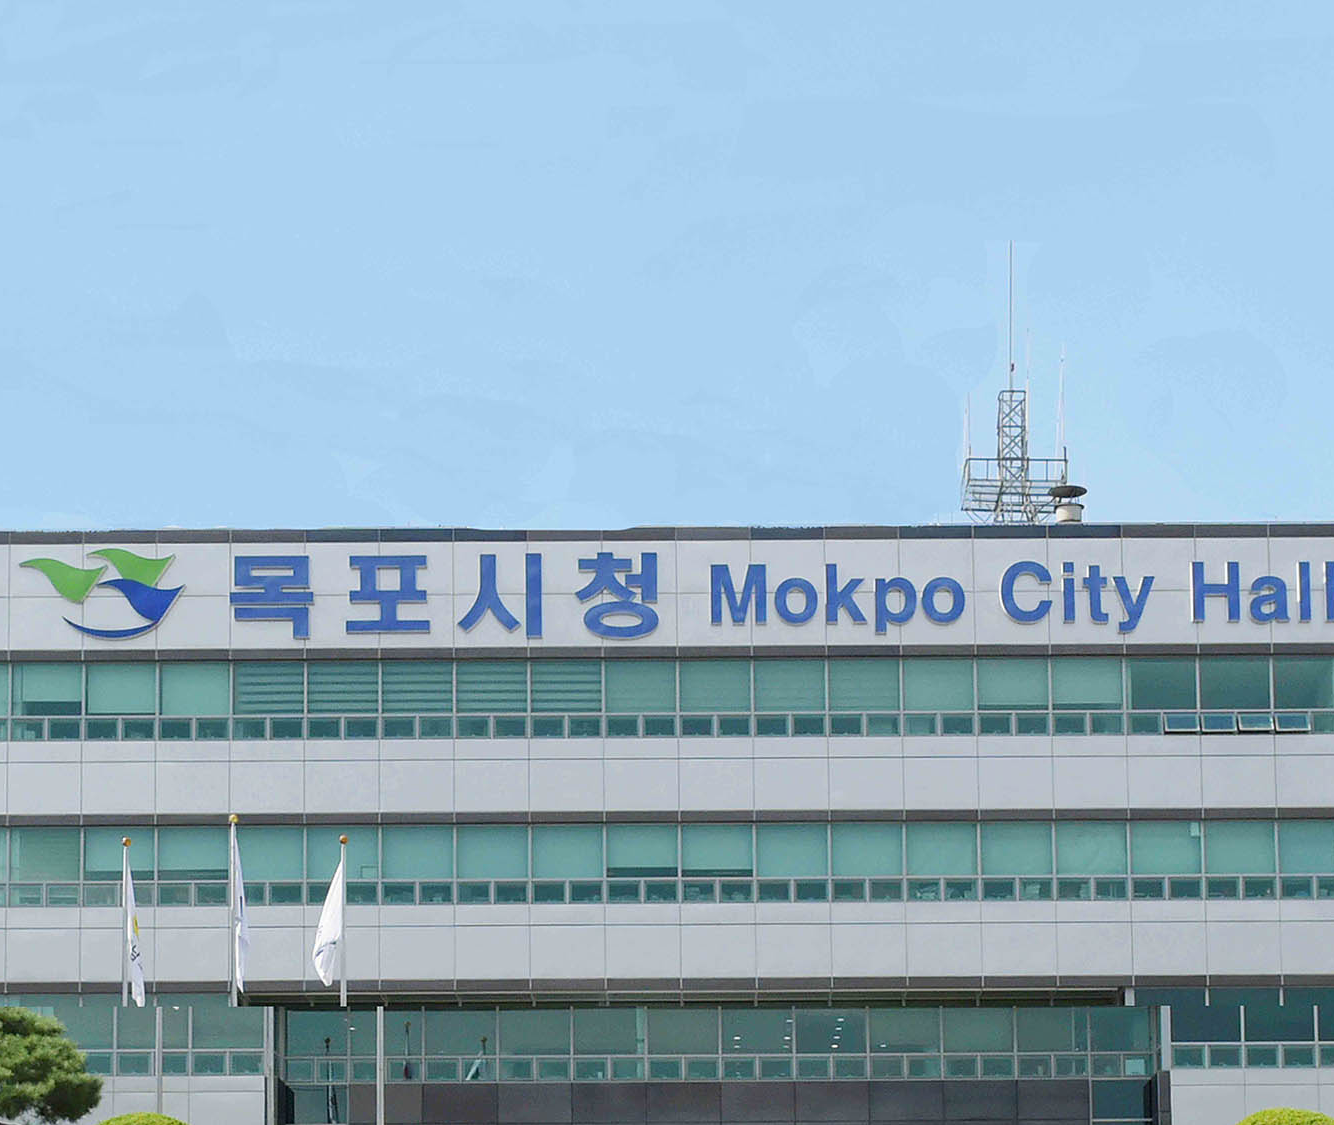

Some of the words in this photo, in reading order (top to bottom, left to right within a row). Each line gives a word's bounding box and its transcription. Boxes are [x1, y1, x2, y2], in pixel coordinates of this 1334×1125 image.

[229, 551, 661, 640] 목포시청
[710, 562, 967, 634] Mokpo
[1000, 559, 1157, 634] City
